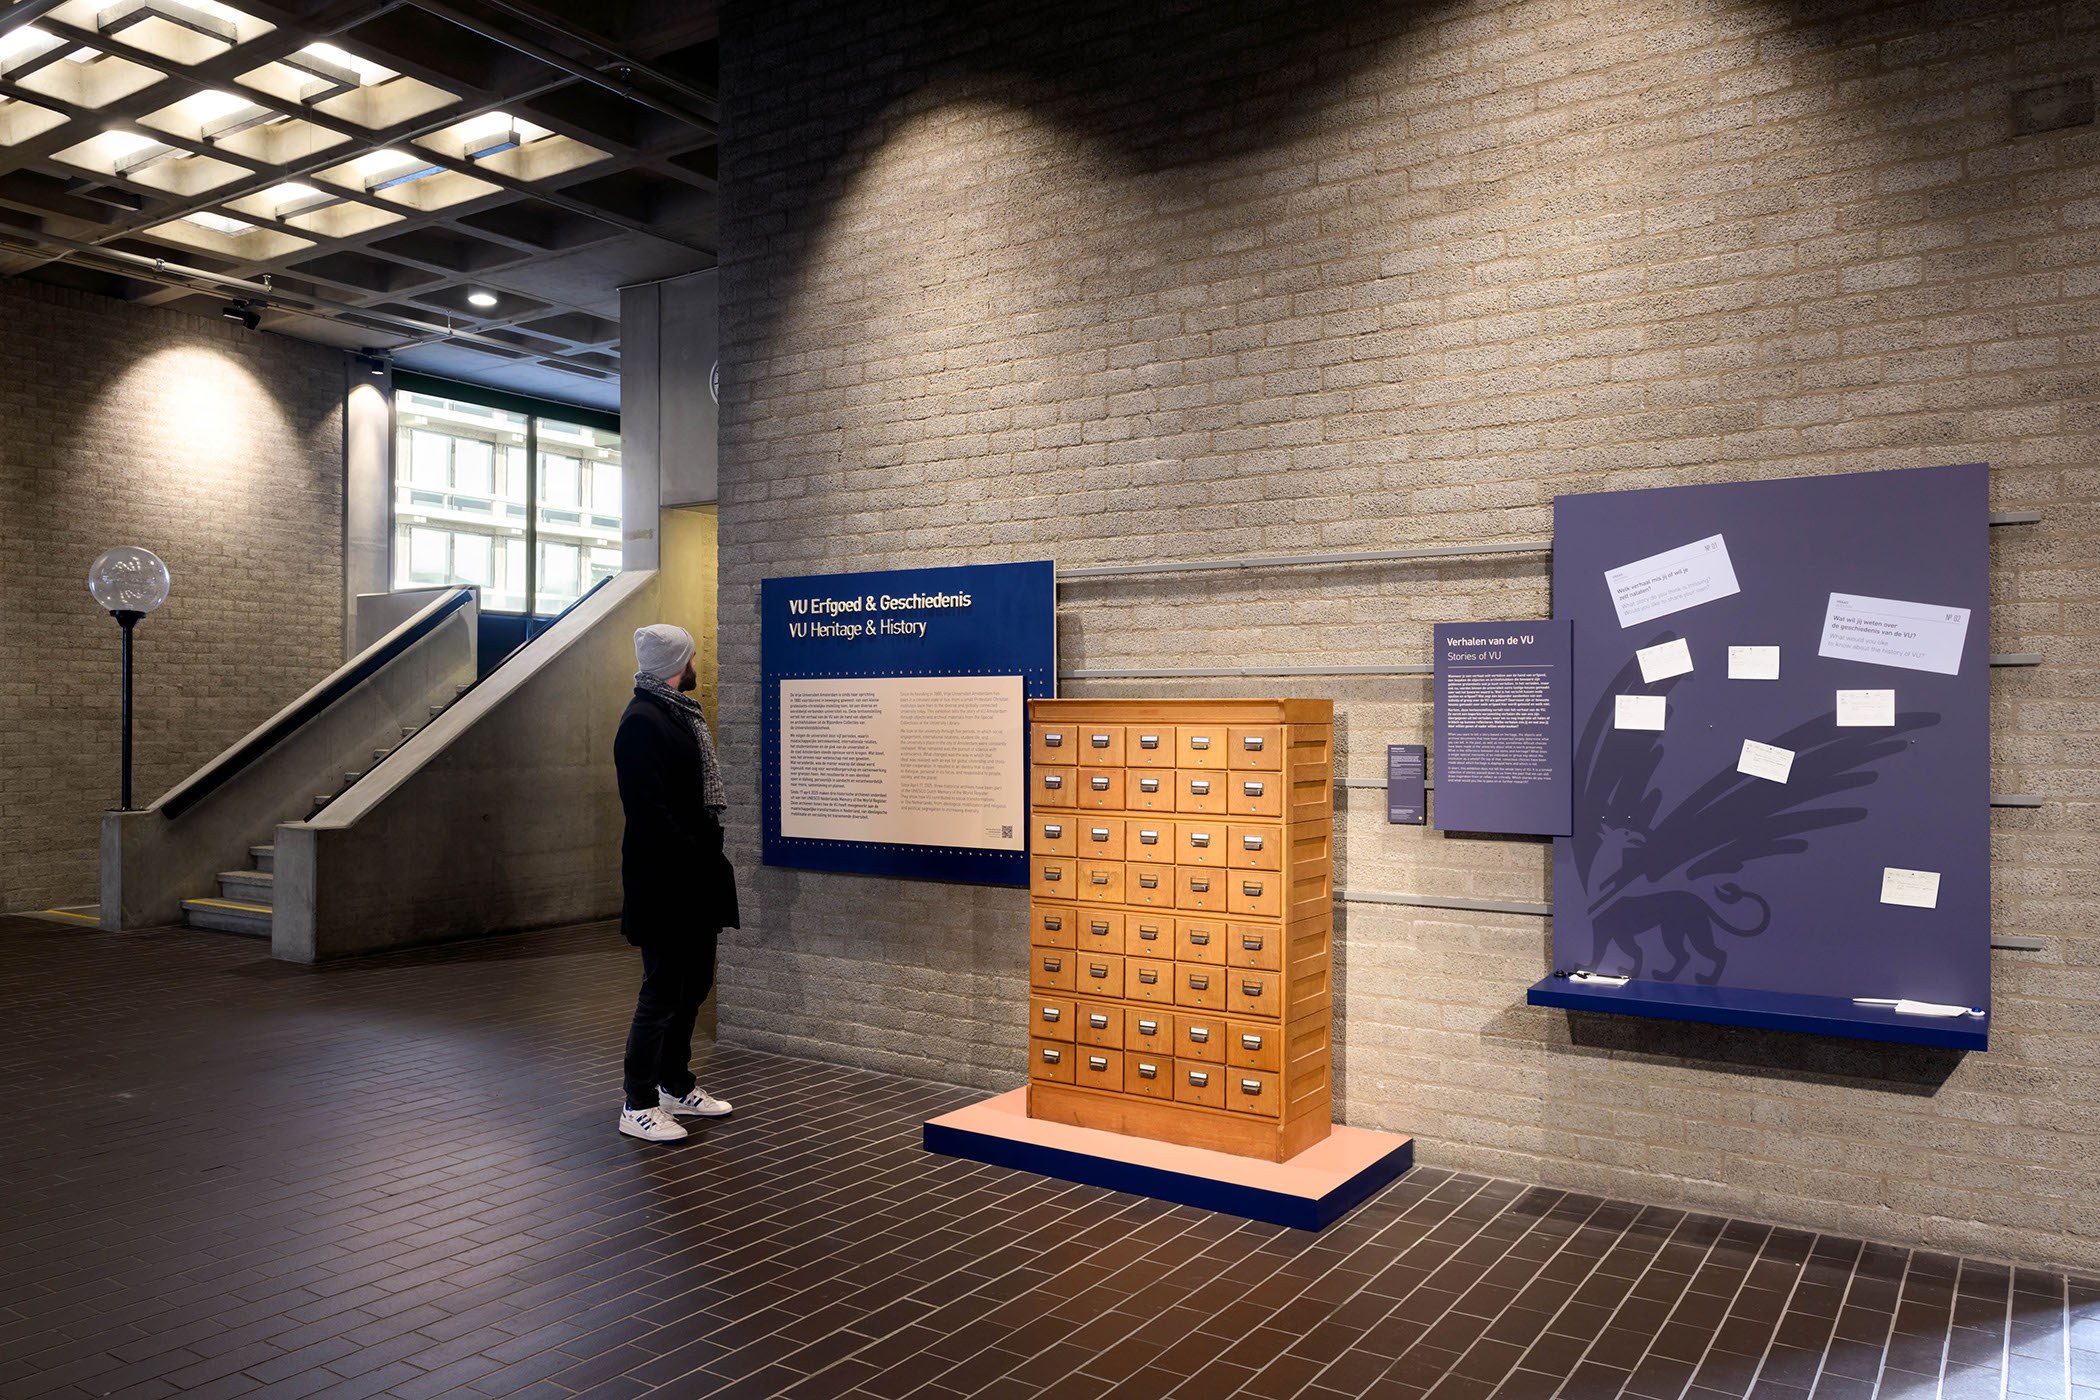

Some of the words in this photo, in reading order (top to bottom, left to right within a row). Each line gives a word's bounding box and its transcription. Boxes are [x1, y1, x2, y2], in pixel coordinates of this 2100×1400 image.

[1631, 580, 1650, 590] verhaal
[790, 600, 808, 614] VU
[811, 597, 862, 616] Erfgoed
[866, 595, 876, 612] &
[880, 591, 972, 610] Geschiedenis
[790, 622, 807, 638] VU
[811, 621, 862, 640] Heritage
[866, 620, 876, 636] &
[880, 618, 927, 638] History
[1840, 624, 1880, 634] geschiedenis
[1447, 637, 1486, 646] Verhalen
[1507, 636, 1518, 645] de
[1520, 636, 1534, 644] VU
[1448, 652, 1476, 660] Stories
[1478, 652, 1487, 660] of
[1488, 652, 1502, 660] VU
